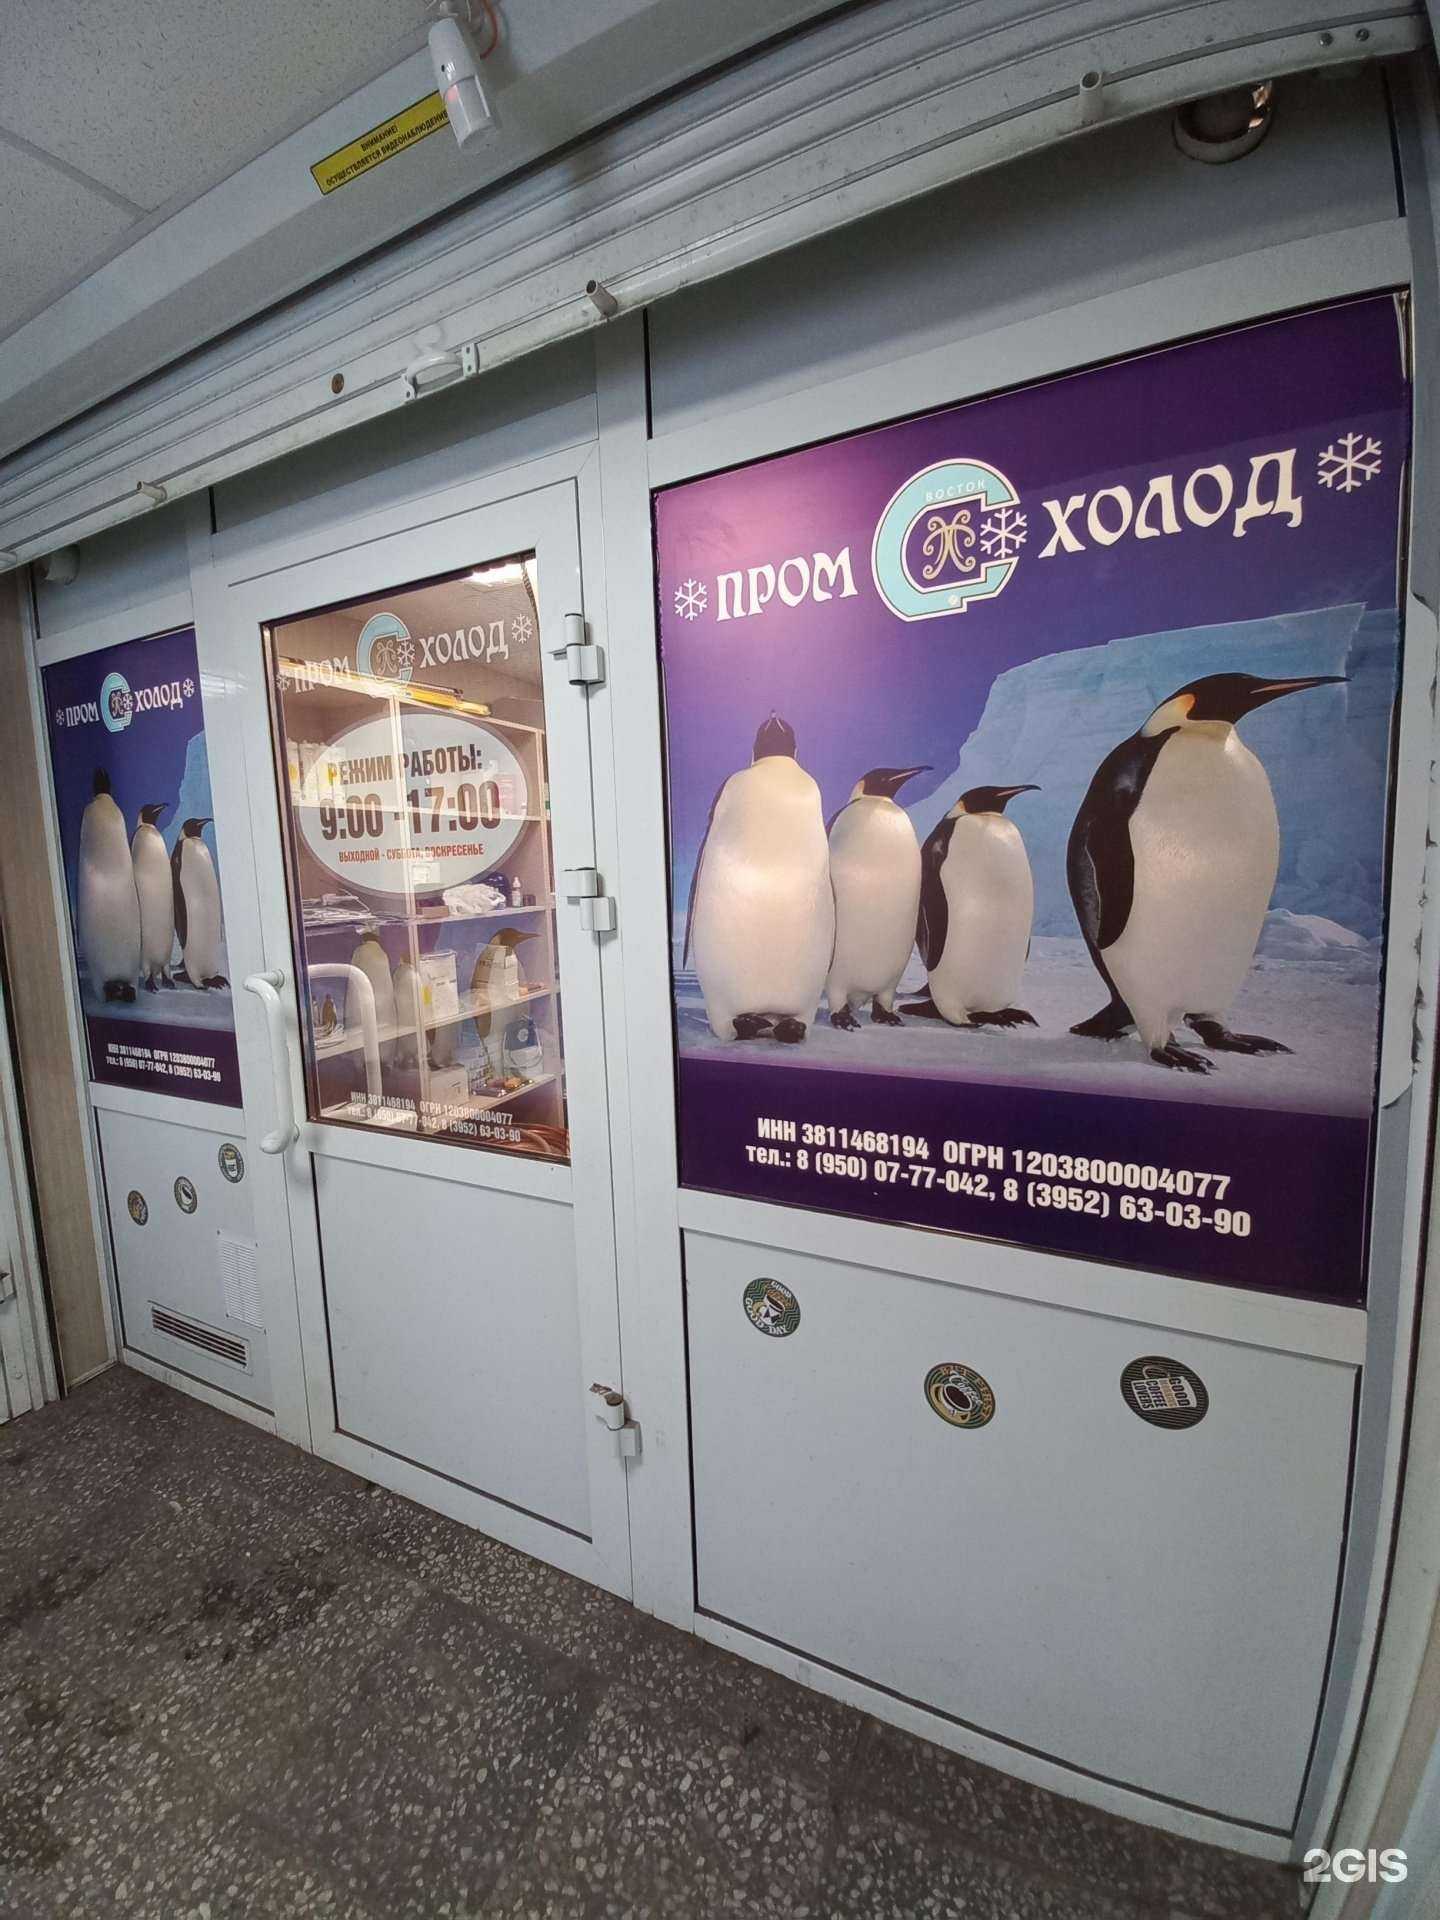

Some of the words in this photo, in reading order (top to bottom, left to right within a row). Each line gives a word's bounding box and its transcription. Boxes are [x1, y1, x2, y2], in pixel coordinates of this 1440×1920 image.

[360, 124, 399, 151] ВНИМАНИЕ!
[325, 148, 382, 187] ОСУЩЕСТВЛЯЕТСЯ
[925, 479, 986, 502] ВОСТОК
[716, 547, 859, 621] ПРОМ
[1038, 448, 1304, 559] ХОЛОД
[419, 620, 509, 668] ХОЛОД
[65, 701, 100, 727] ПРОМ
[134, 681, 184, 712] ХОЛОД
[327, 755, 394, 787] РЕЖИМ
[398, 744, 483, 778] РАБОТЫ:
[320, 793, 384, 840] 9:00
[407, 781, 501, 834] 17:00
[339, 847, 380, 863] ВЫХОДНОЙ
[424, 843, 484, 859] ВОСКРЕСЕНЬЕ
[420, 1100, 441, 1115] ОГРН
[450, 1120, 478, 1136] (3952)
[480, 1124, 521, 1142] 63-03-90
[757, 1117, 797, 1143] ИНН
[801, 1122, 929, 1160] 3811468194
[943, 1140, 1005, 1171] ОГРН
[1011, 1149, 1232, 1201] 1203800004077
[745, 1143, 792, 1169] тел.:
[796, 1149, 809, 1170] 8
[814, 1152, 867, 1181] (950)
[874, 1161, 996, 1203] 07-77-042,
[1003, 1178, 1019, 1201] 8
[1026, 1182, 1110, 1218] (3952)
[1119, 1197, 1252, 1238] 63-03-90
[769, 1325, 787, 1335] DAY
[1132, 1381, 1155, 1409] LOVERS
[1145, 1380, 1168, 1408] COFFEE
[1169, 1377, 1191, 1407] GOOD
